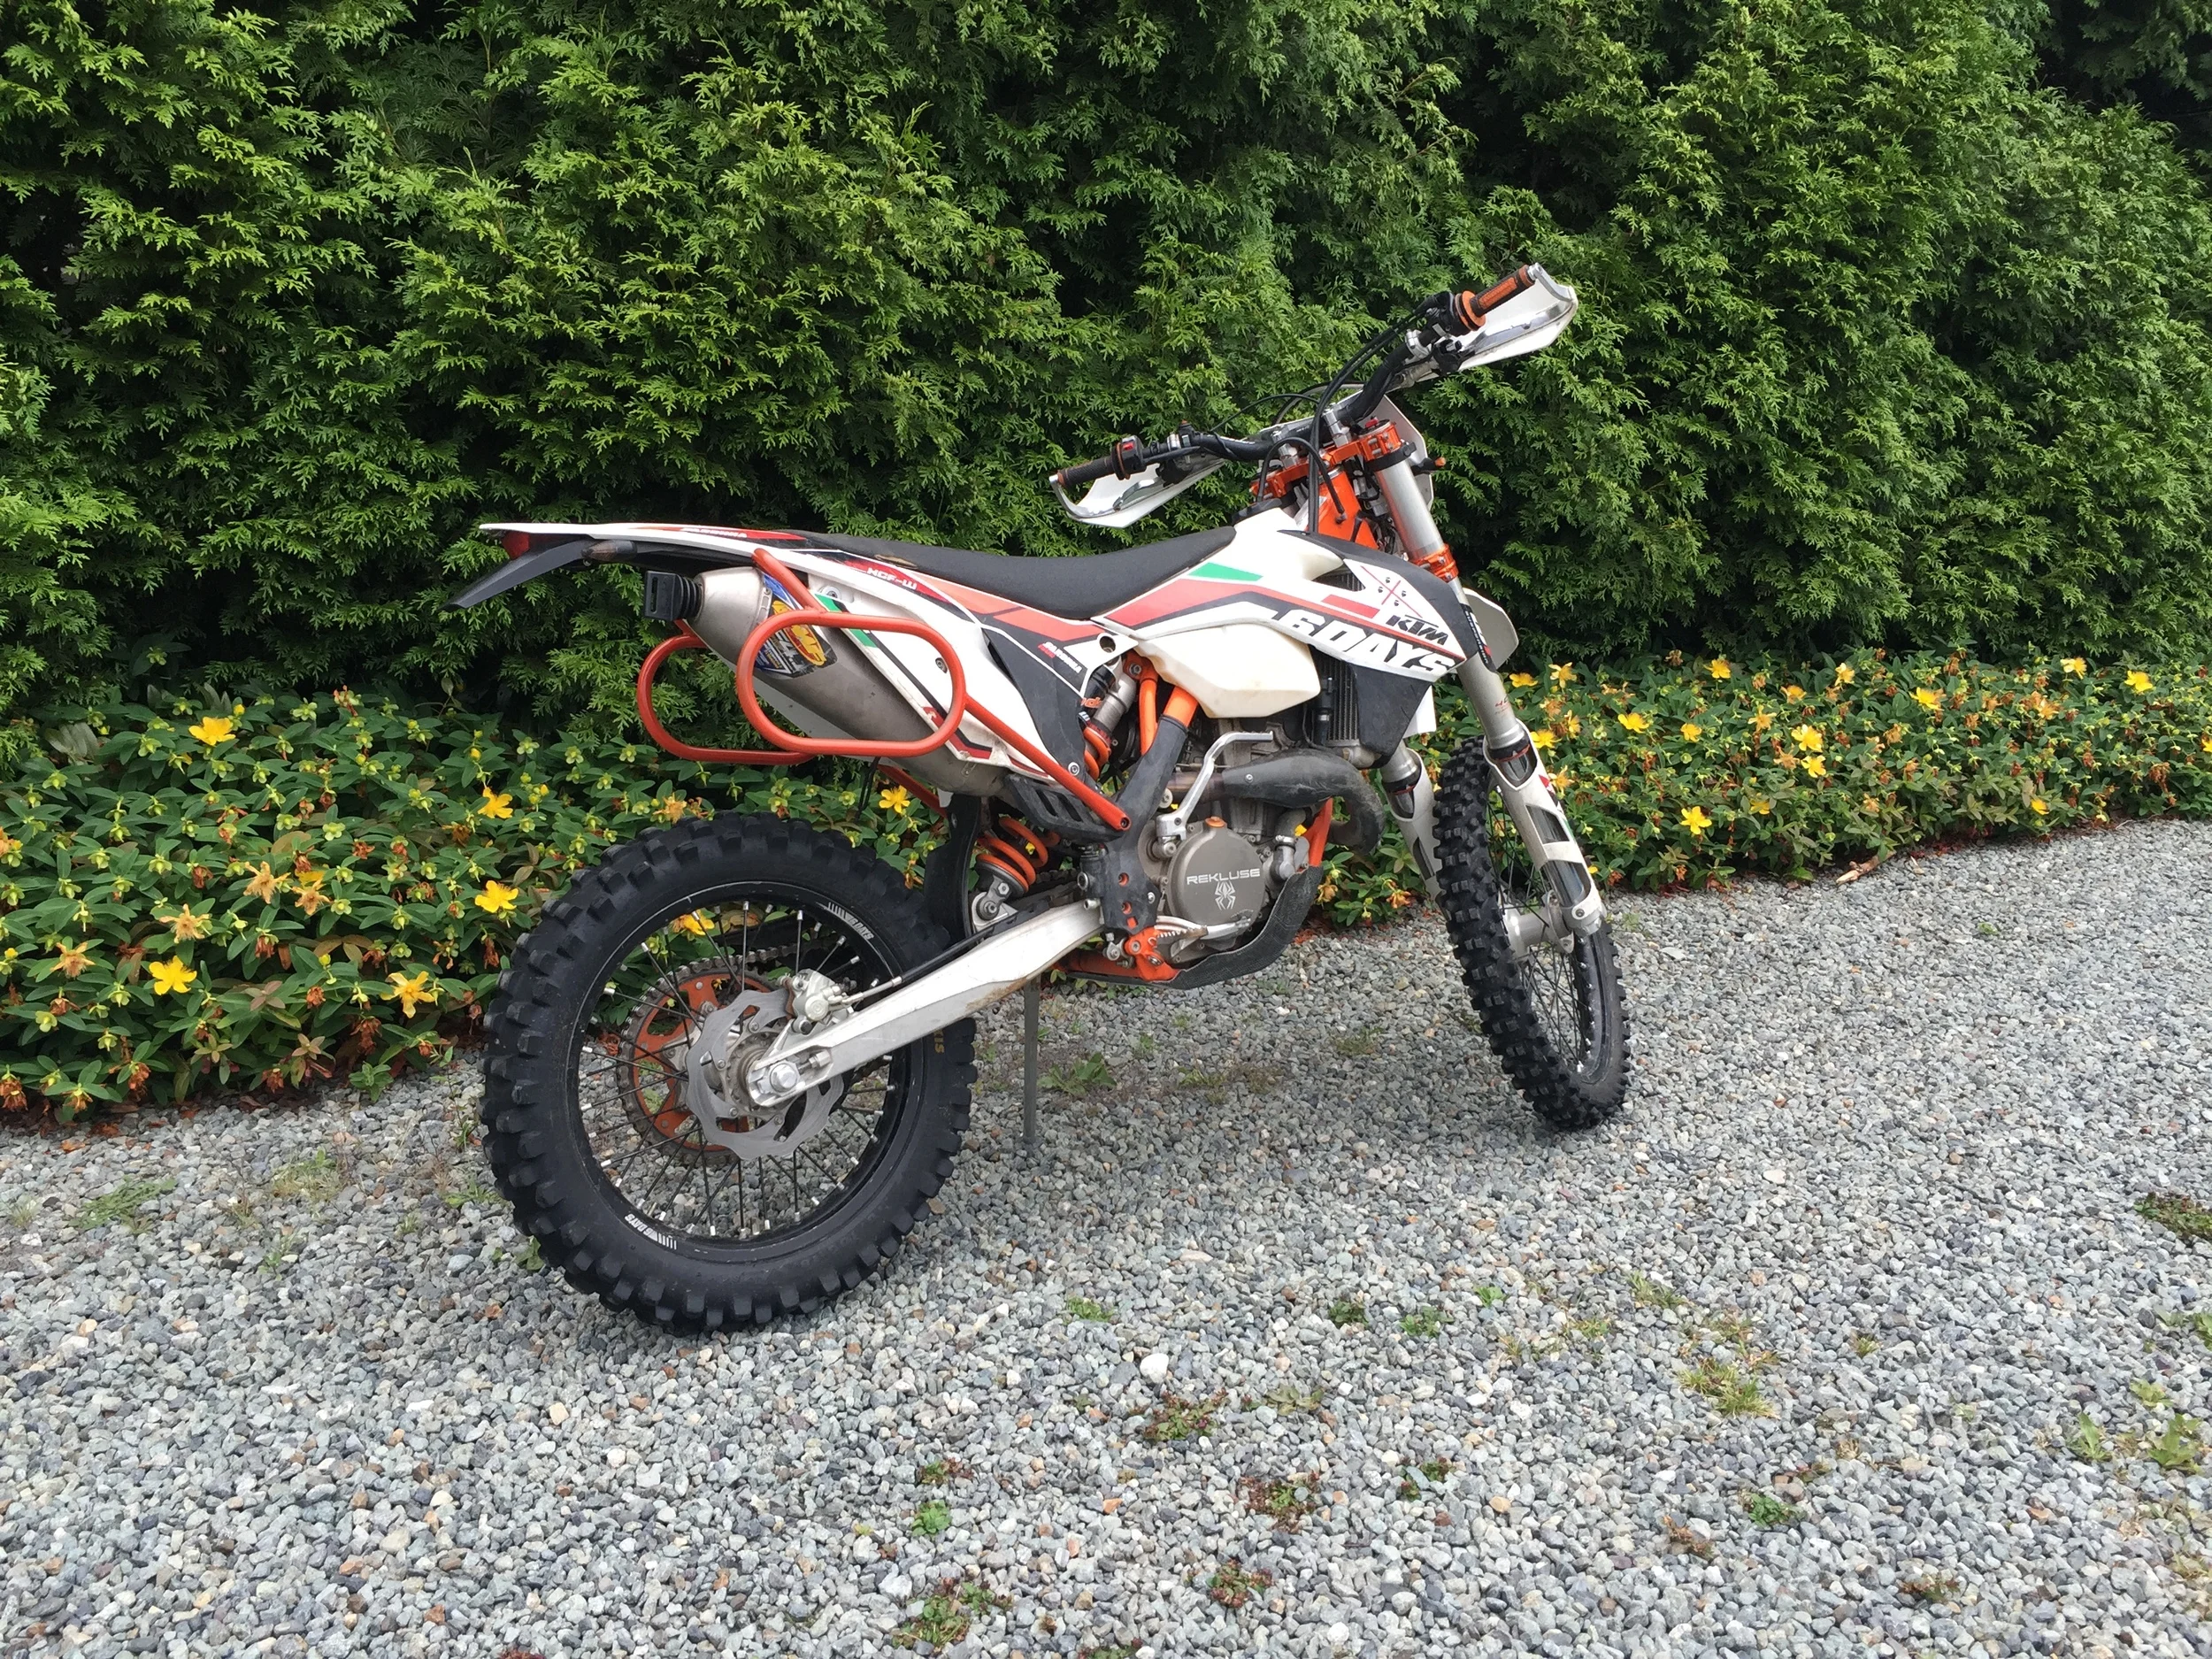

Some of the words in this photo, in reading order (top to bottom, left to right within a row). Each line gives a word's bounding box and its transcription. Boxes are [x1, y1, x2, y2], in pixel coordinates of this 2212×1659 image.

[1278, 609, 1456, 674] 6DAYS
[1386, 615, 1448, 645] KTM
[1187, 868, 1261, 886] REKLUSE
